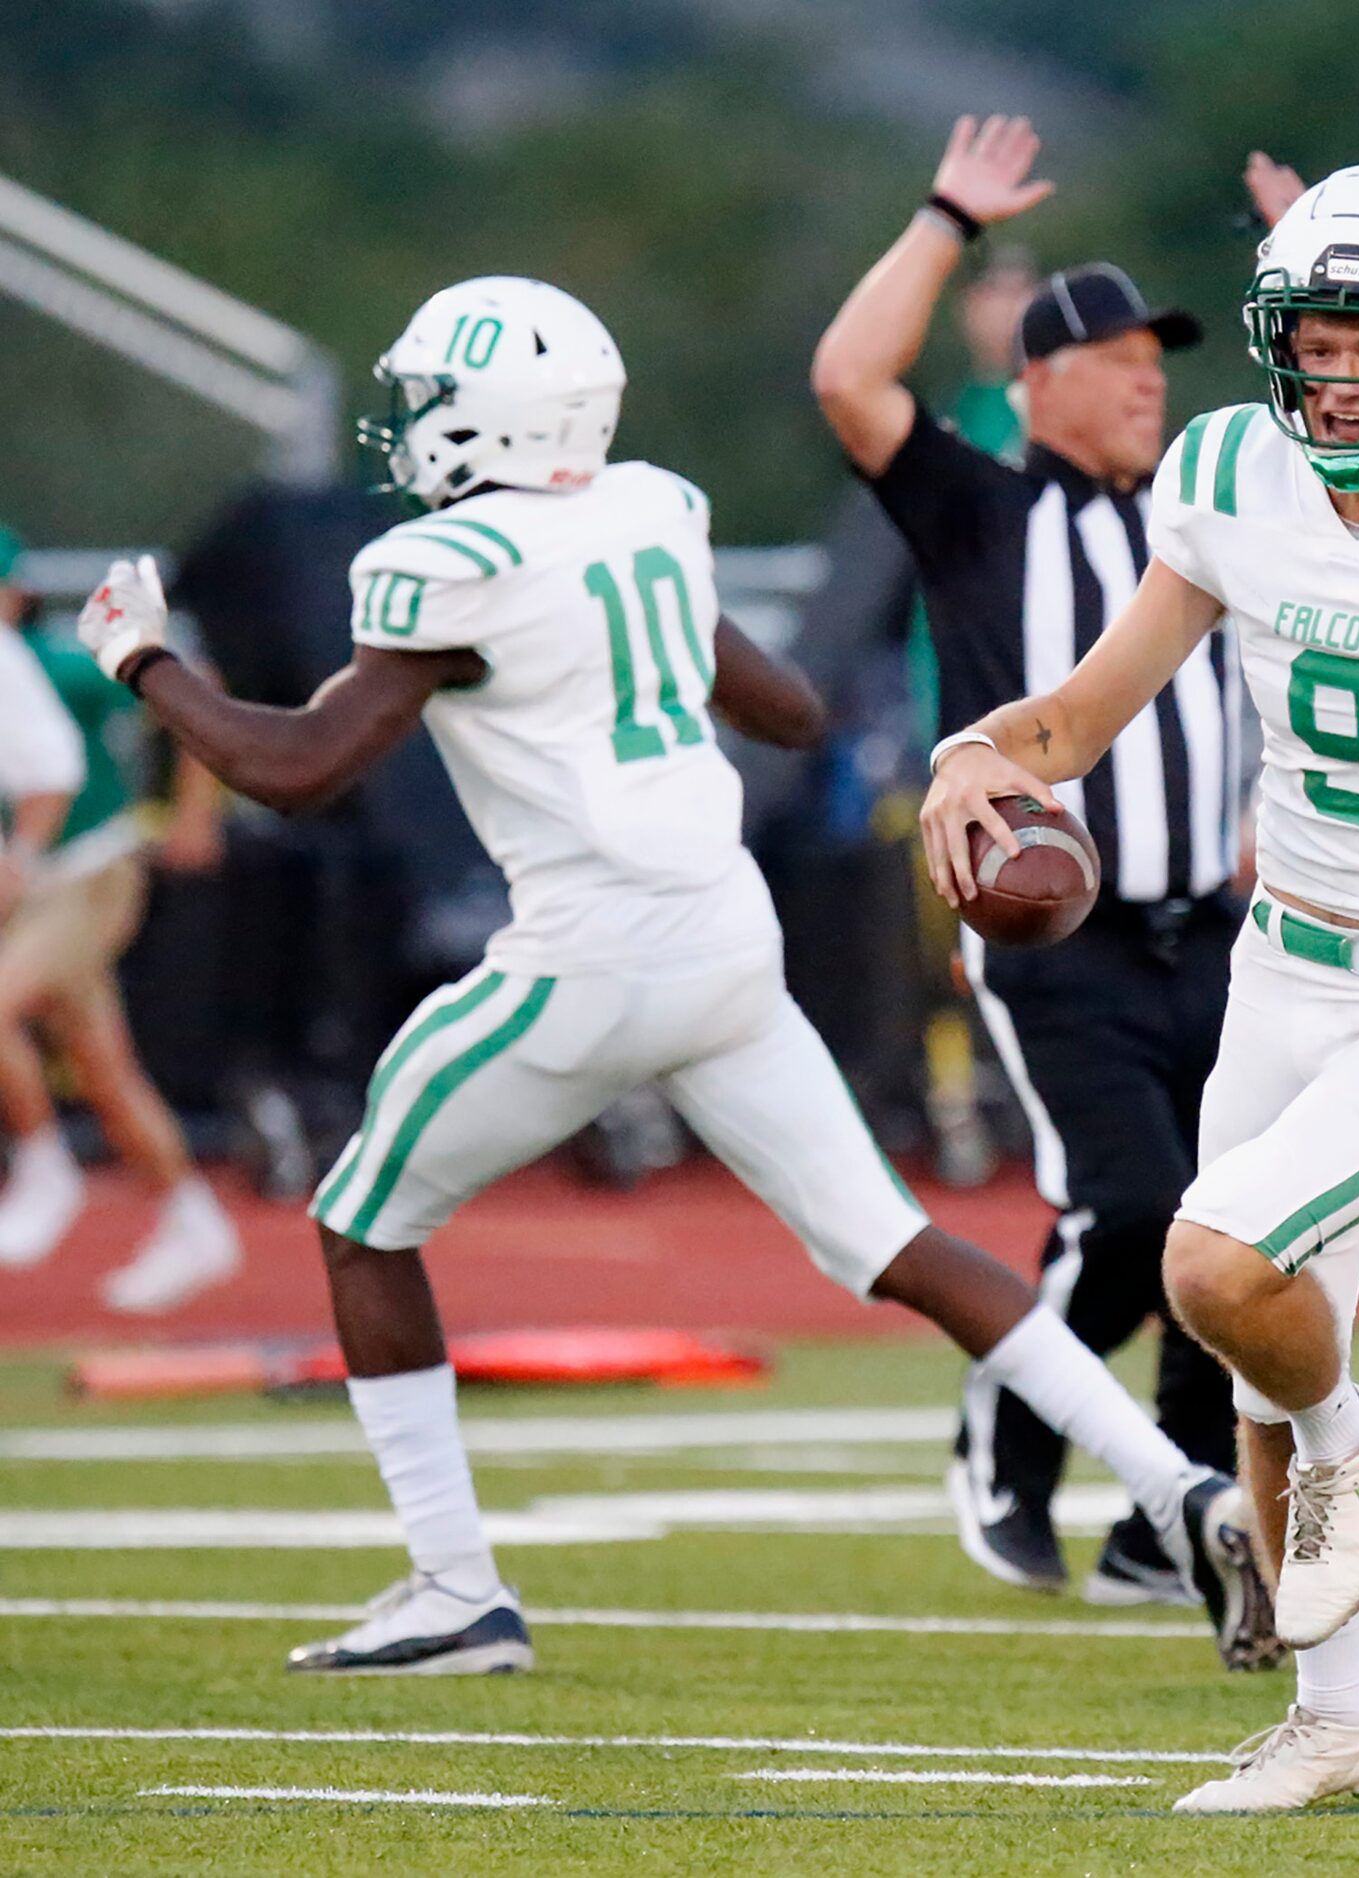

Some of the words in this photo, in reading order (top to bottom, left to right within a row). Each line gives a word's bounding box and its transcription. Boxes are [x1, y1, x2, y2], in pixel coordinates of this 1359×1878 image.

[445, 314, 502, 369] 10
[361, 569, 427, 637] 10
[584, 546, 716, 763] 10
